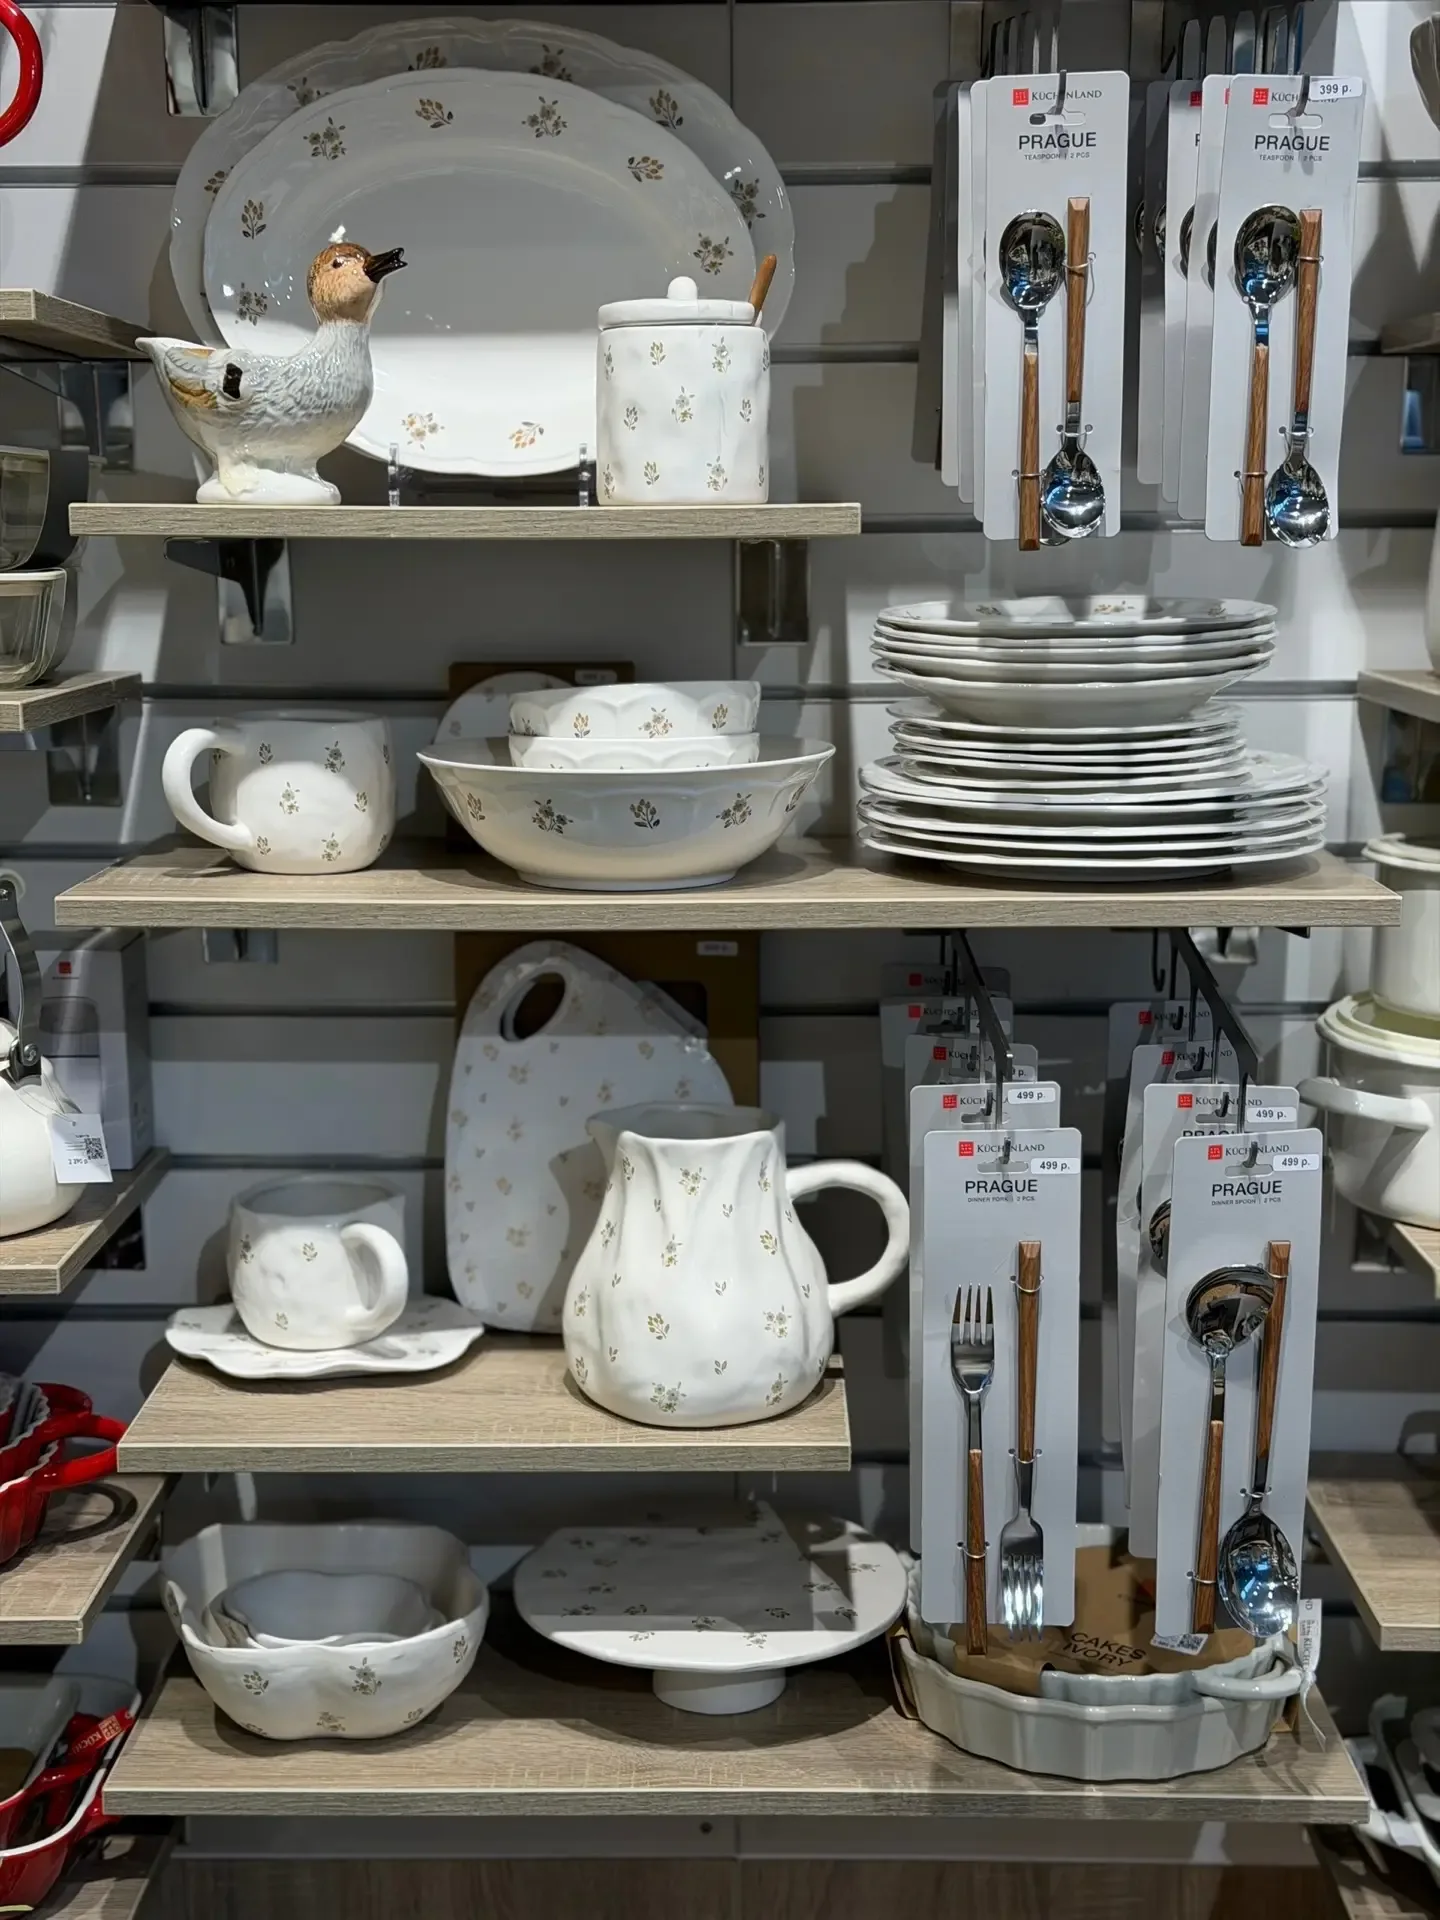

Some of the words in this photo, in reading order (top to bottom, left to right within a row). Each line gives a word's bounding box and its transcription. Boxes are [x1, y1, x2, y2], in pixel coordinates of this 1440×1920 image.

[1031, 89, 1103, 101] KÜCHNLAND
[1319, 84, 1339, 95] 399
[1018, 132, 1097, 150] PRAGUE
[1254, 135, 1331, 151] PRAGUE
[1024, 153, 1061, 161] TEASPOON
[1016, 1091, 1035, 1100] 499
[1255, 1109, 1275, 1118] 499
[977, 1143, 1045, 1154] KÜCHNLAND
[1225, 1144, 1290, 1157] KÜCHNLAND
[1039, 1161, 1058, 1170] 499
[1281, 1157, 1300, 1167] 499
[965, 1179, 1039, 1194] PRAGUE
[1211, 1180, 1283, 1198] PRAGUE
[1211, 1198, 1234, 1206] DINNER
[1071, 1631, 1148, 1661] CAKES
[1062, 1642, 1134, 1667] IVORY
